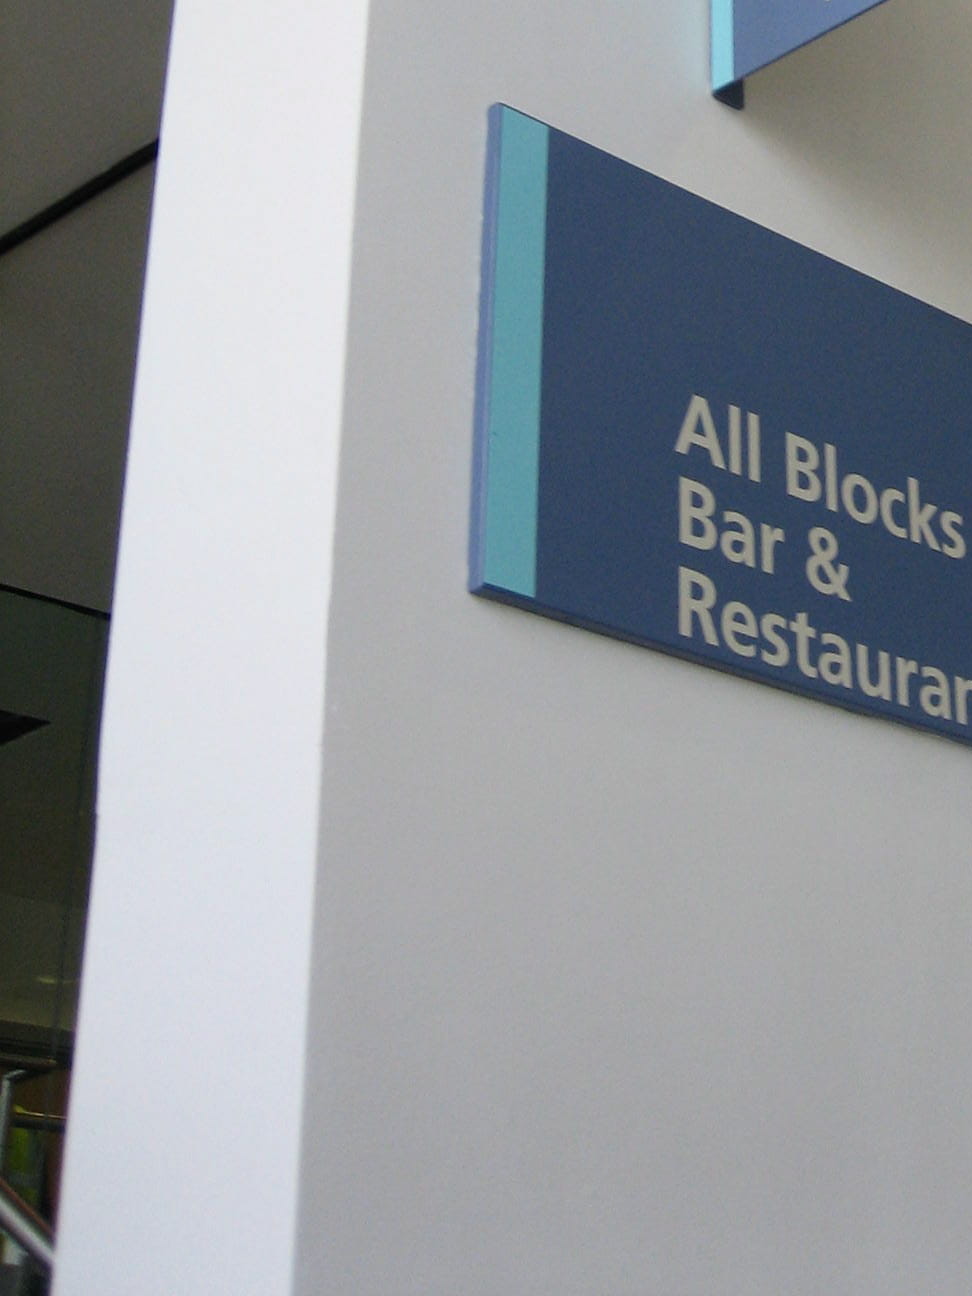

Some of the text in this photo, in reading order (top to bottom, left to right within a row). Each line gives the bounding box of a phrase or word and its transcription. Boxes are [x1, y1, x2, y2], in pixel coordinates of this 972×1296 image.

[674, 394, 967, 560] All Blocks
[678, 475, 852, 602] Bar &
